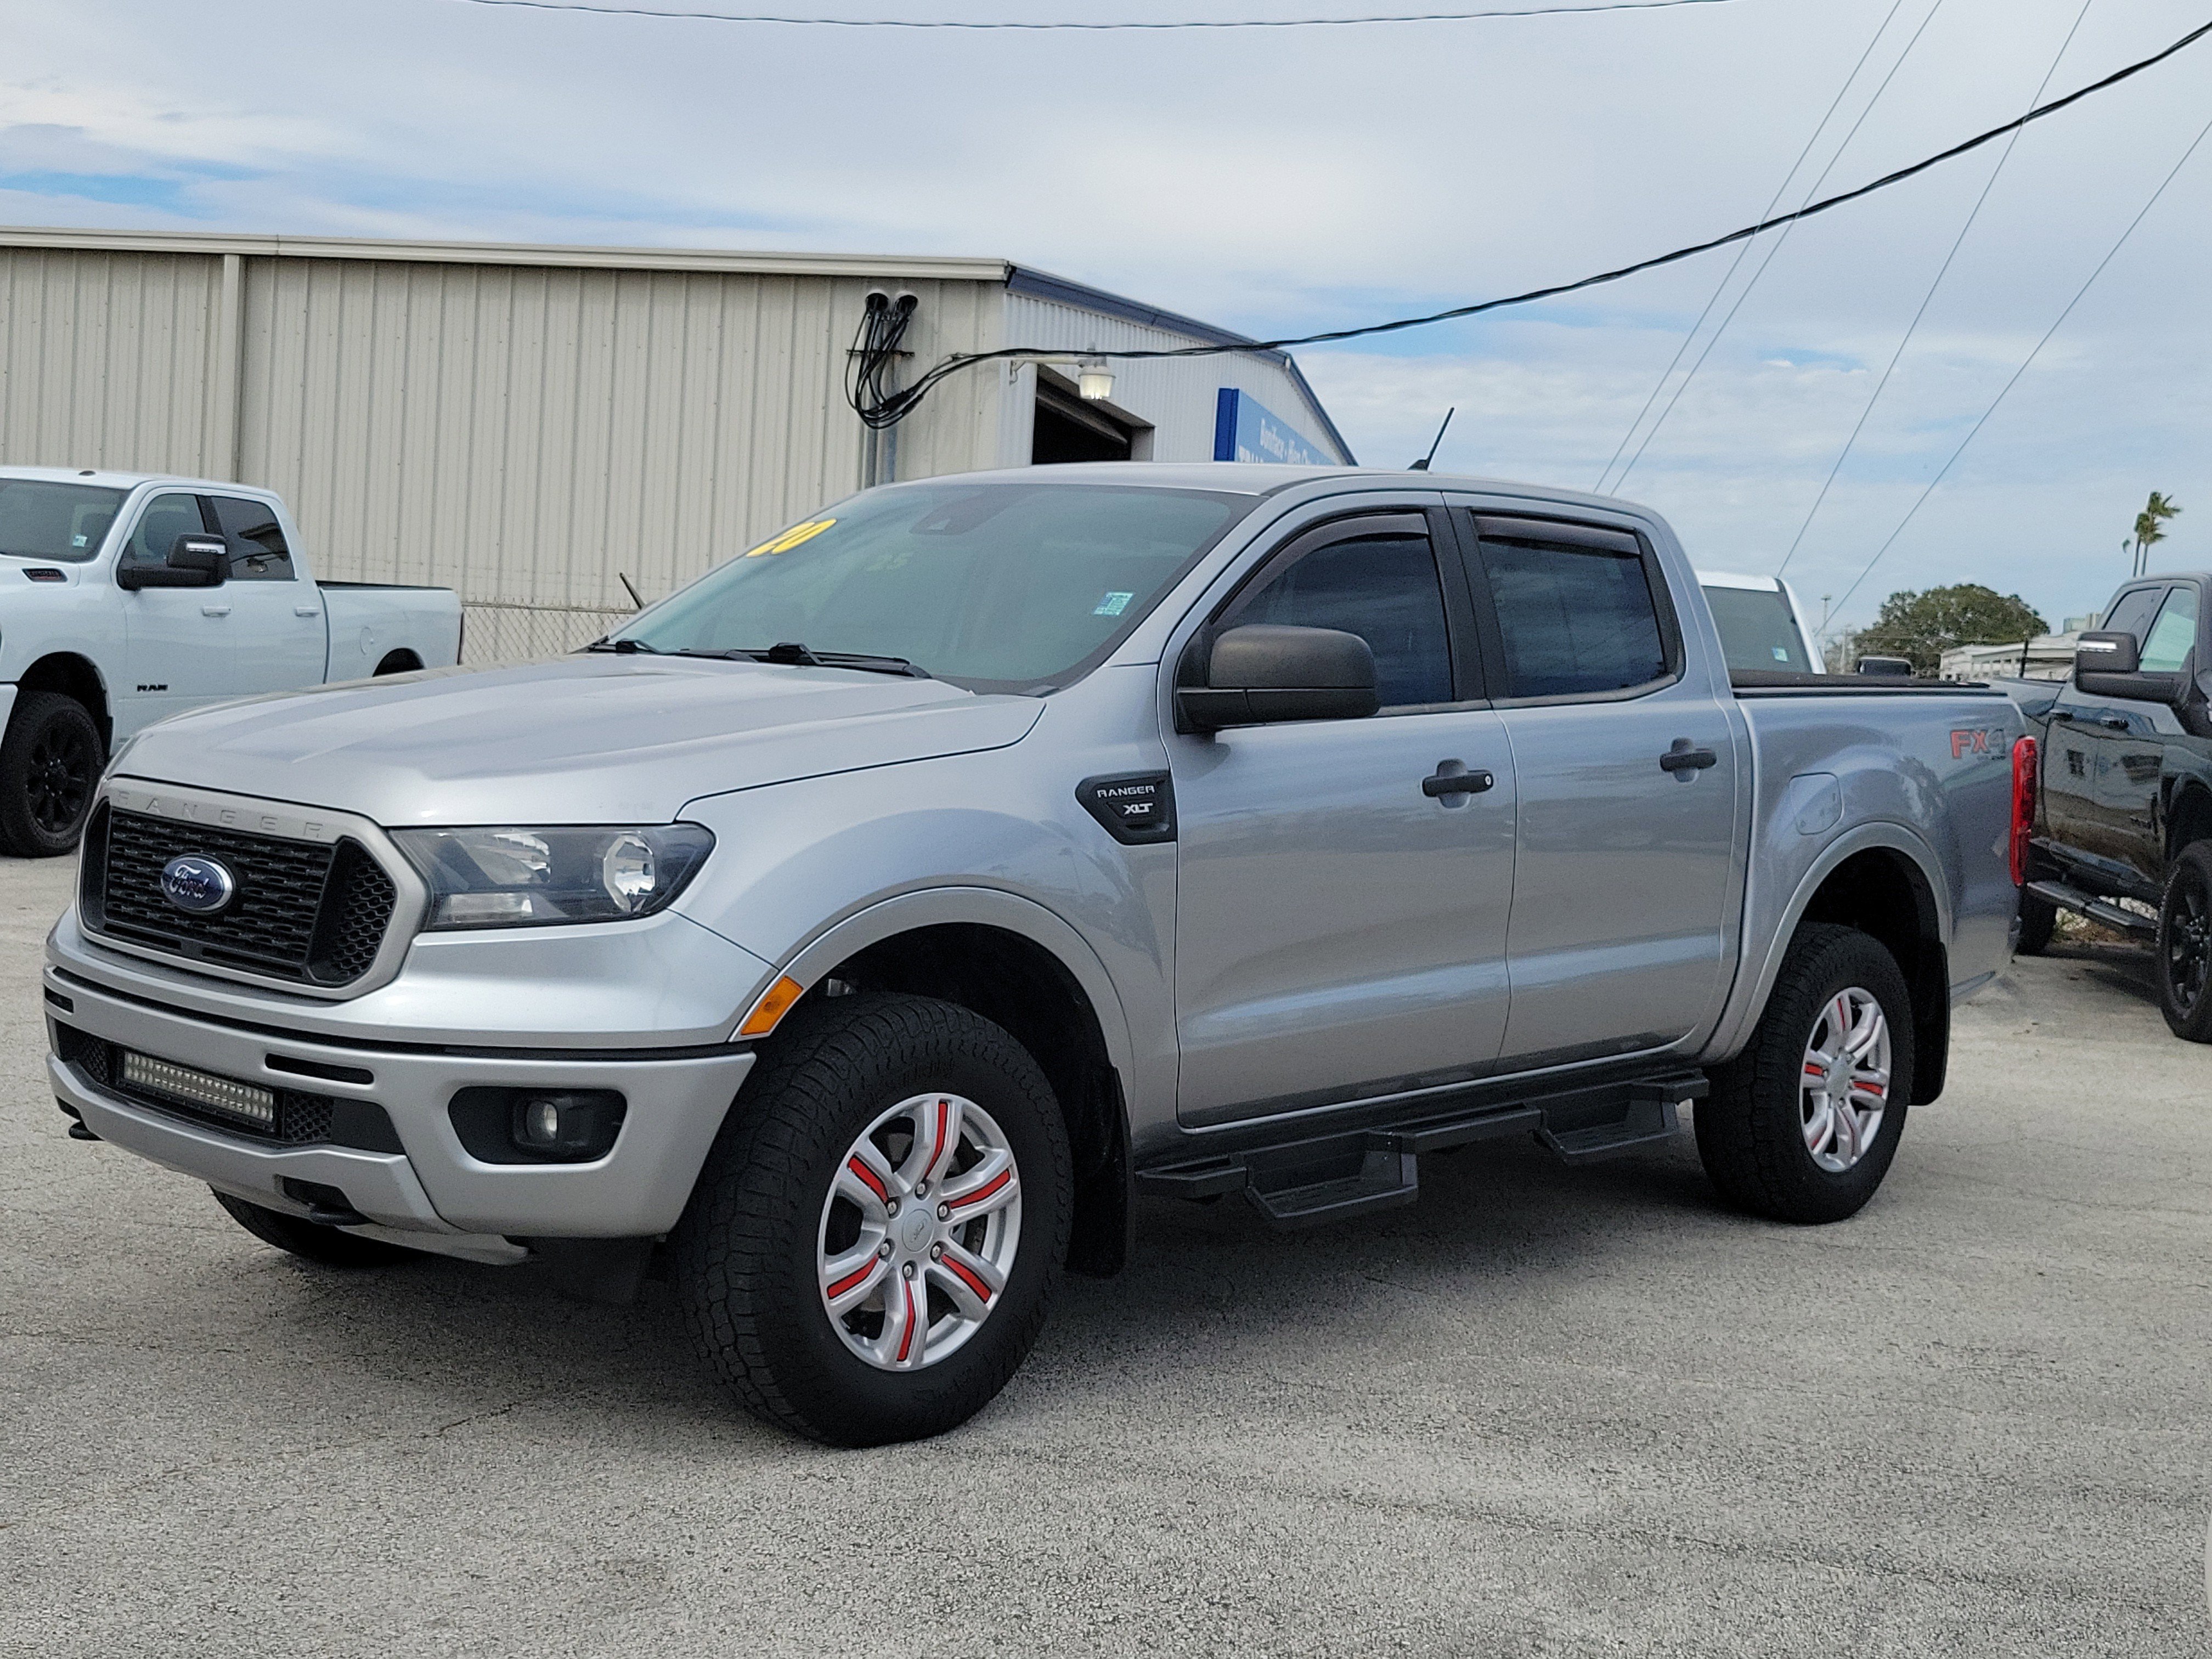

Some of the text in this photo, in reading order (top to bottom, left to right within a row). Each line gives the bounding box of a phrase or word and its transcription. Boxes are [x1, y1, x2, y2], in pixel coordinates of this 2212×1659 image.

[746, 518, 838, 558] 20
[1950, 729, 2006, 760] FX4
[1097, 785, 1155, 798] RANGER
[116, 790, 325, 839] RANGER
[1122, 802, 1154, 815] XLT
[169, 864, 210, 899] Ford
